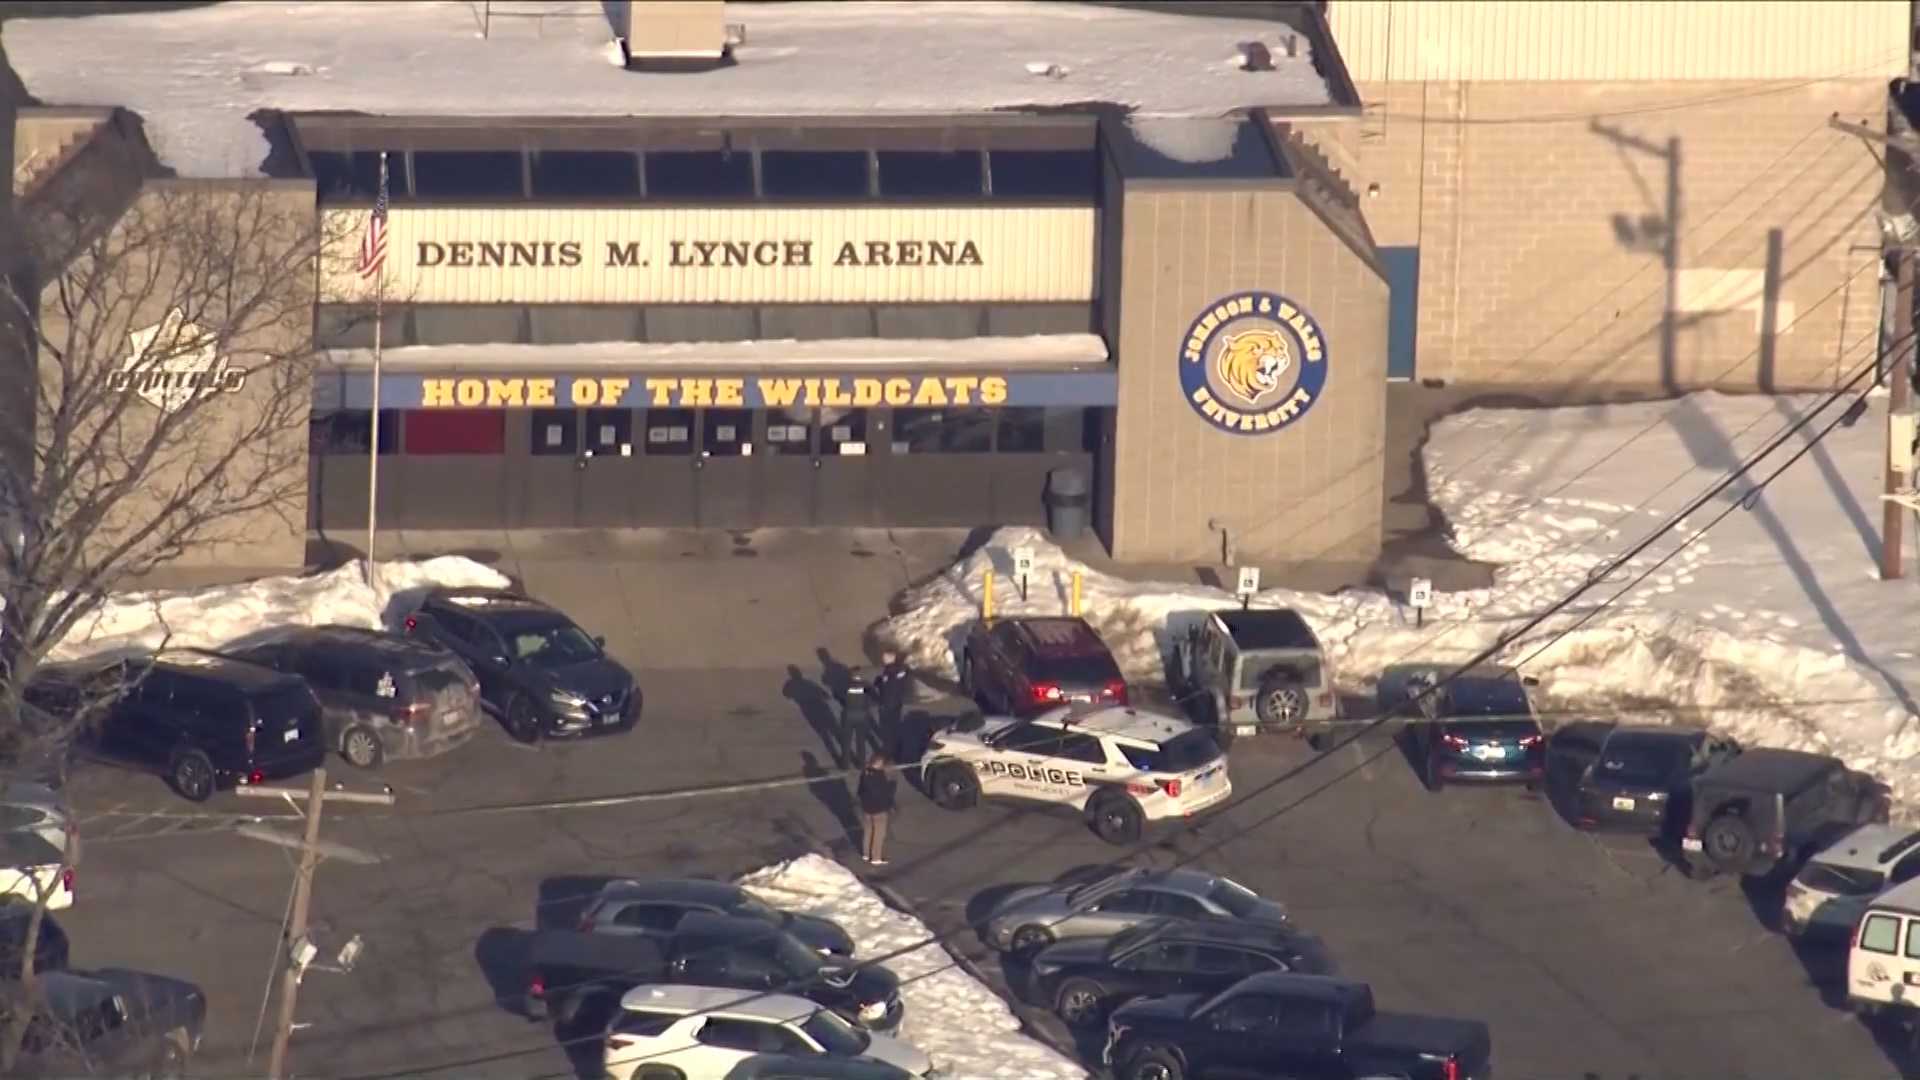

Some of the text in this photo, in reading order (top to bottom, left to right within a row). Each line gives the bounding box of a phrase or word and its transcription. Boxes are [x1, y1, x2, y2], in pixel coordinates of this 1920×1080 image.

[417, 241, 984, 267] DENNIS M. LYNCH ARENA
[1185, 297, 1322, 362] JOHNSON & WALES
[421, 377, 1008, 407] HOME OF THE WILDCATS
[1193, 388, 1310, 430] UNIVERSITY
[990, 761, 1083, 787] POLICE
